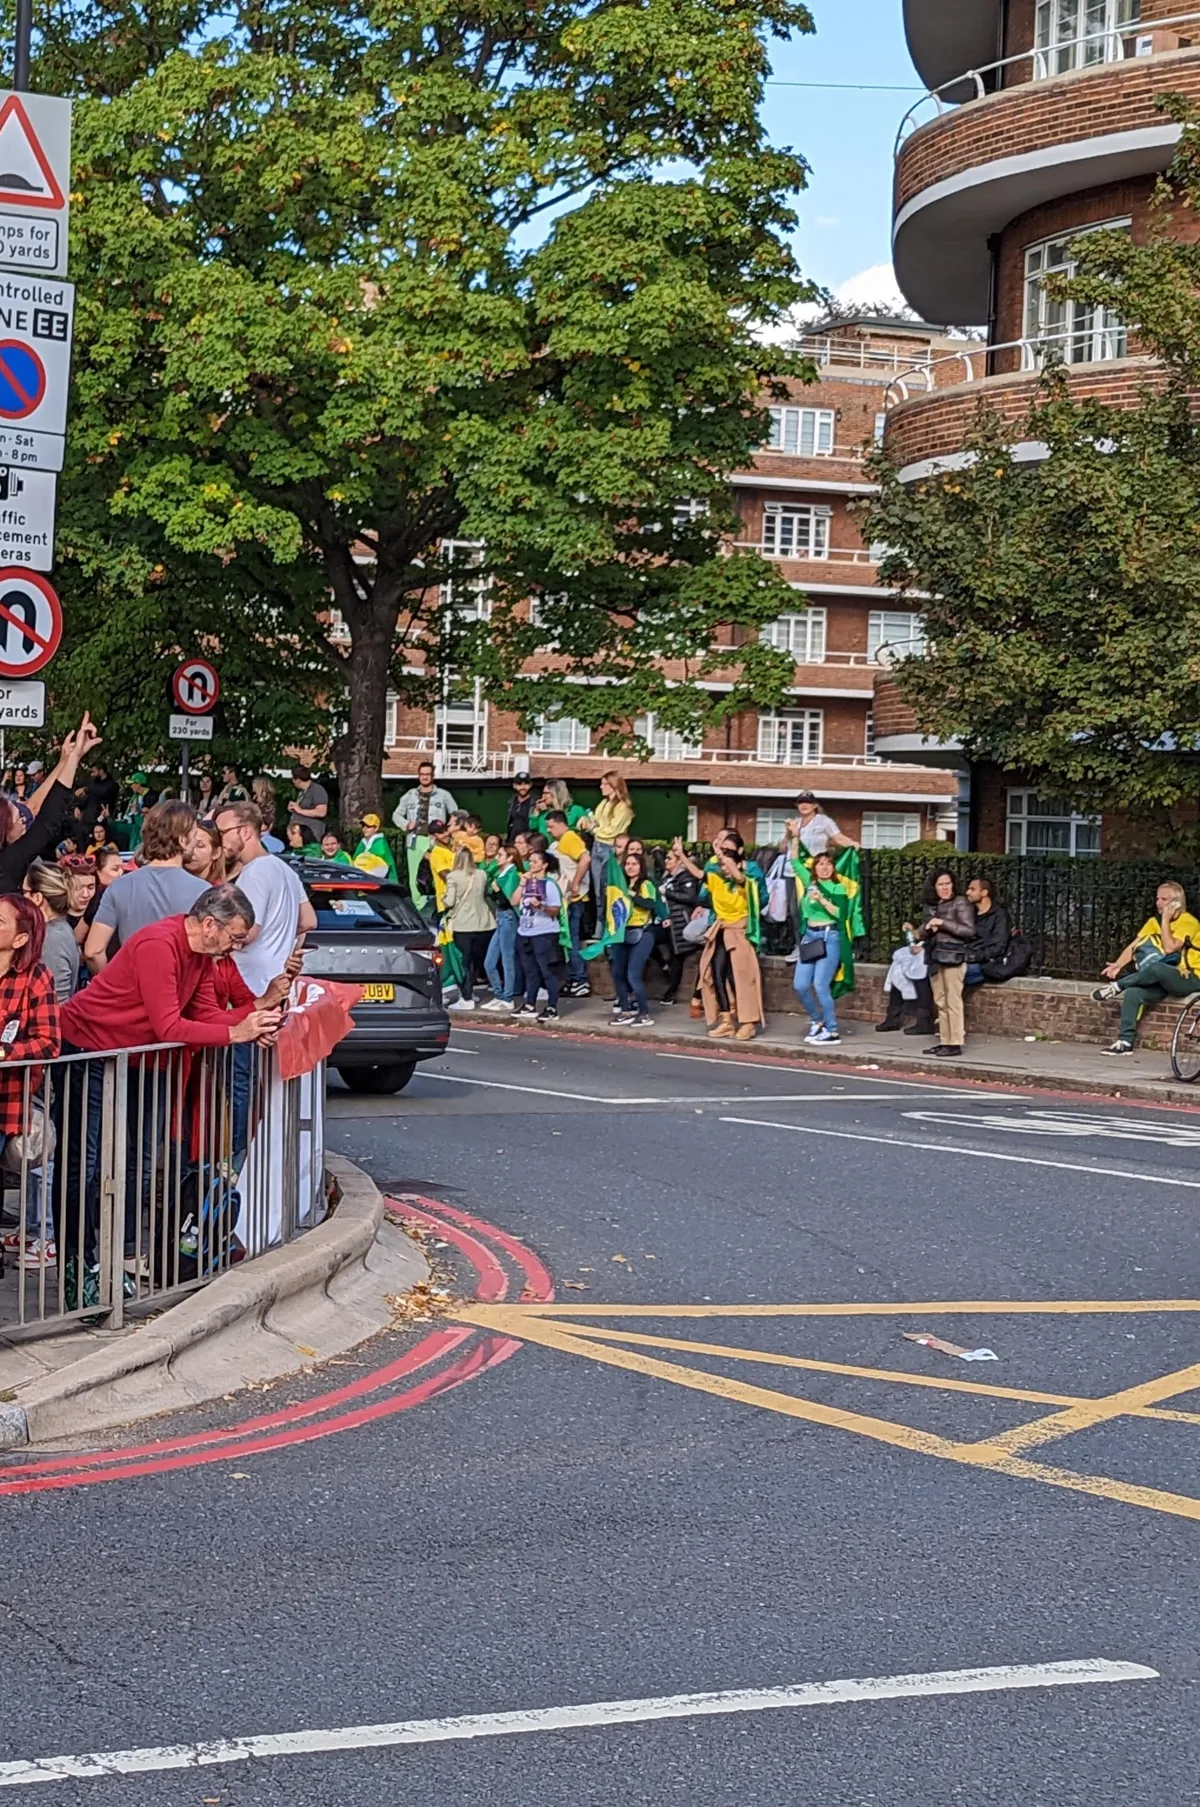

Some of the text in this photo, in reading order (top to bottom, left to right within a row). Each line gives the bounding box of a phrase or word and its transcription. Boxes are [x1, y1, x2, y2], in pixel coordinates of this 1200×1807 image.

[30, 225, 50, 241] for
[9, 244, 50, 259] yards
[36, 312, 65, 338] EE
[14, 434, 35, 447] Sat
[185, 718, 197, 726] For
[190, 728, 210, 736] yards
[368, 984, 390, 998] UBV
